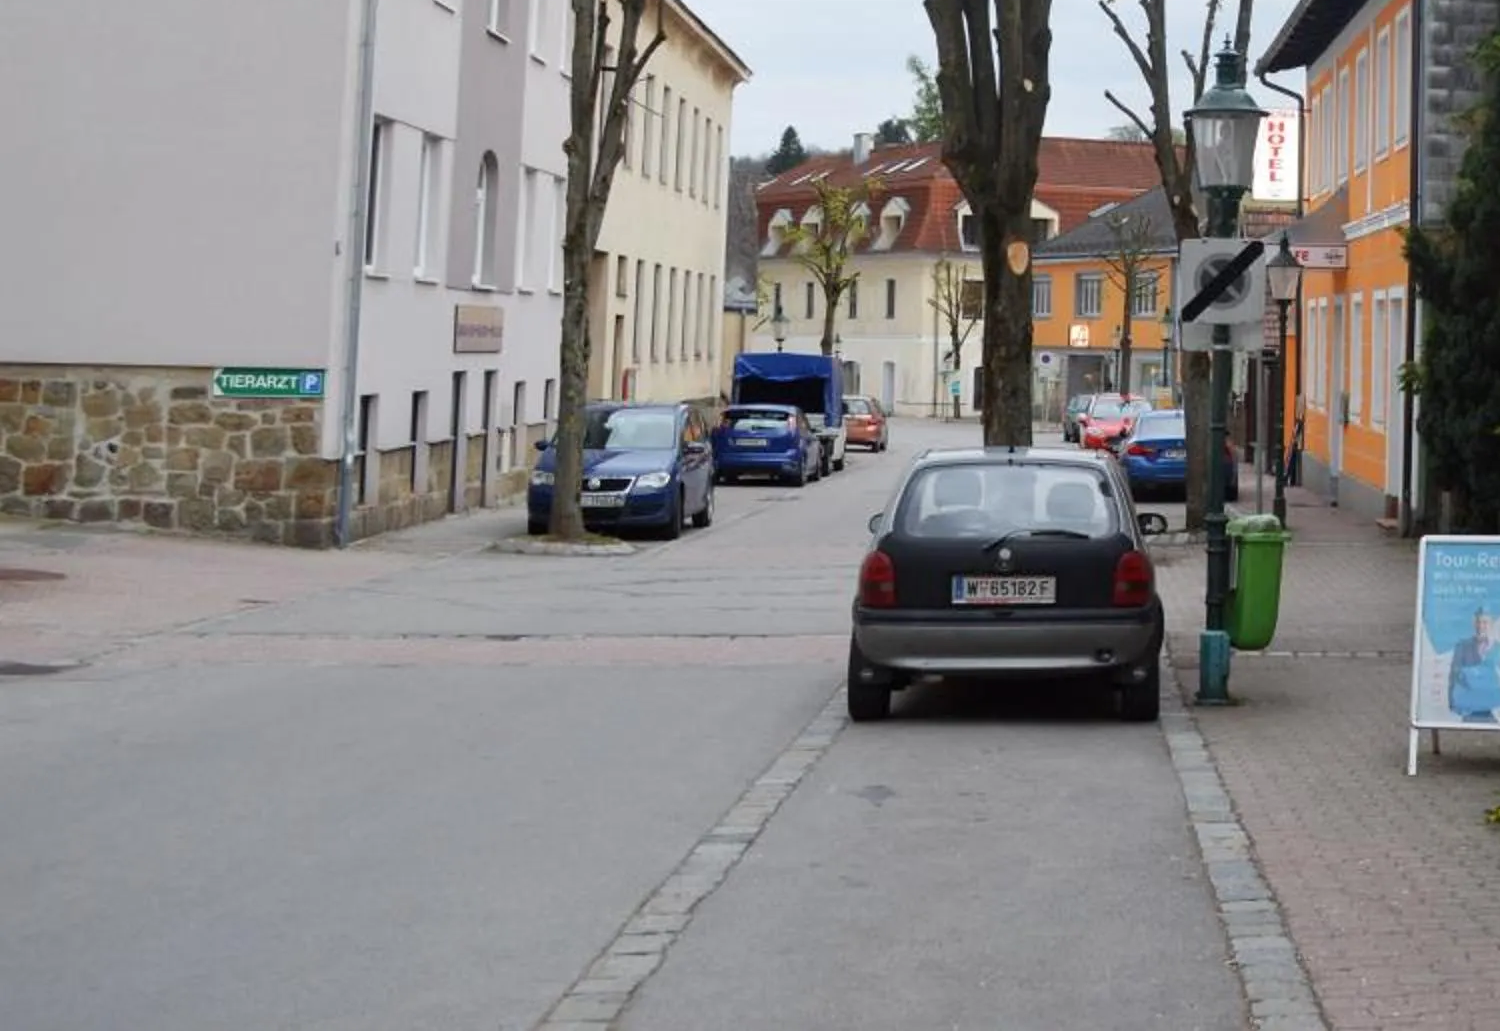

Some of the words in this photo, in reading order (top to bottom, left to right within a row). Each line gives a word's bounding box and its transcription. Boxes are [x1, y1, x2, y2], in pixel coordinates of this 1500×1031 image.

[1267, 121, 1286, 182] HOTEL
[219, 373, 298, 389] TIERARZT
[304, 374, 319, 390] P
[967, 580, 978, 597] W
